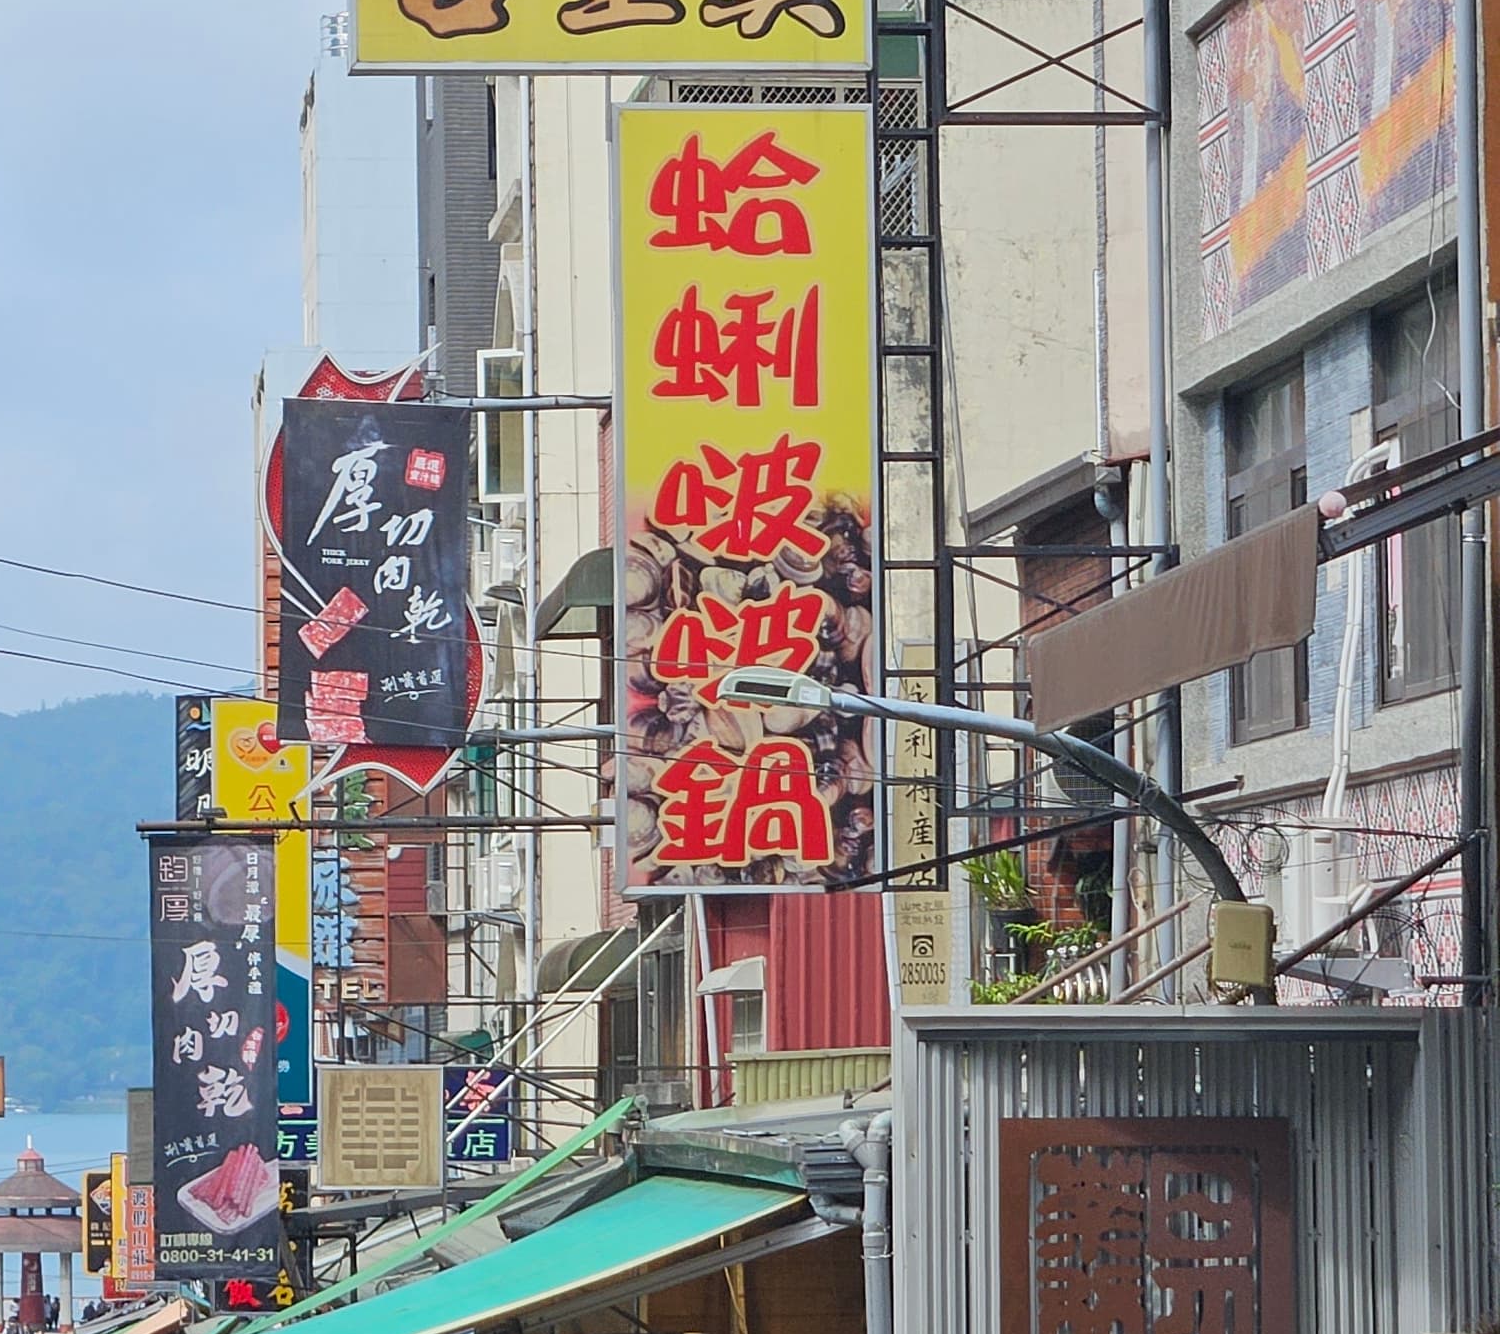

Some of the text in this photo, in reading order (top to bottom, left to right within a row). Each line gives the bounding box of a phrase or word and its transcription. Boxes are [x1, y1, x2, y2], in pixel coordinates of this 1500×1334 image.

[647, 130, 833, 865] 蛤蜊啵啵鍋
[346, 558, 371, 567] JERKY
[901, 962, 945, 986] 2850035
[171, 940, 253, 1117] 厚切肉乾
[160, 1248, 274, 1264] 0800-31-41-31
